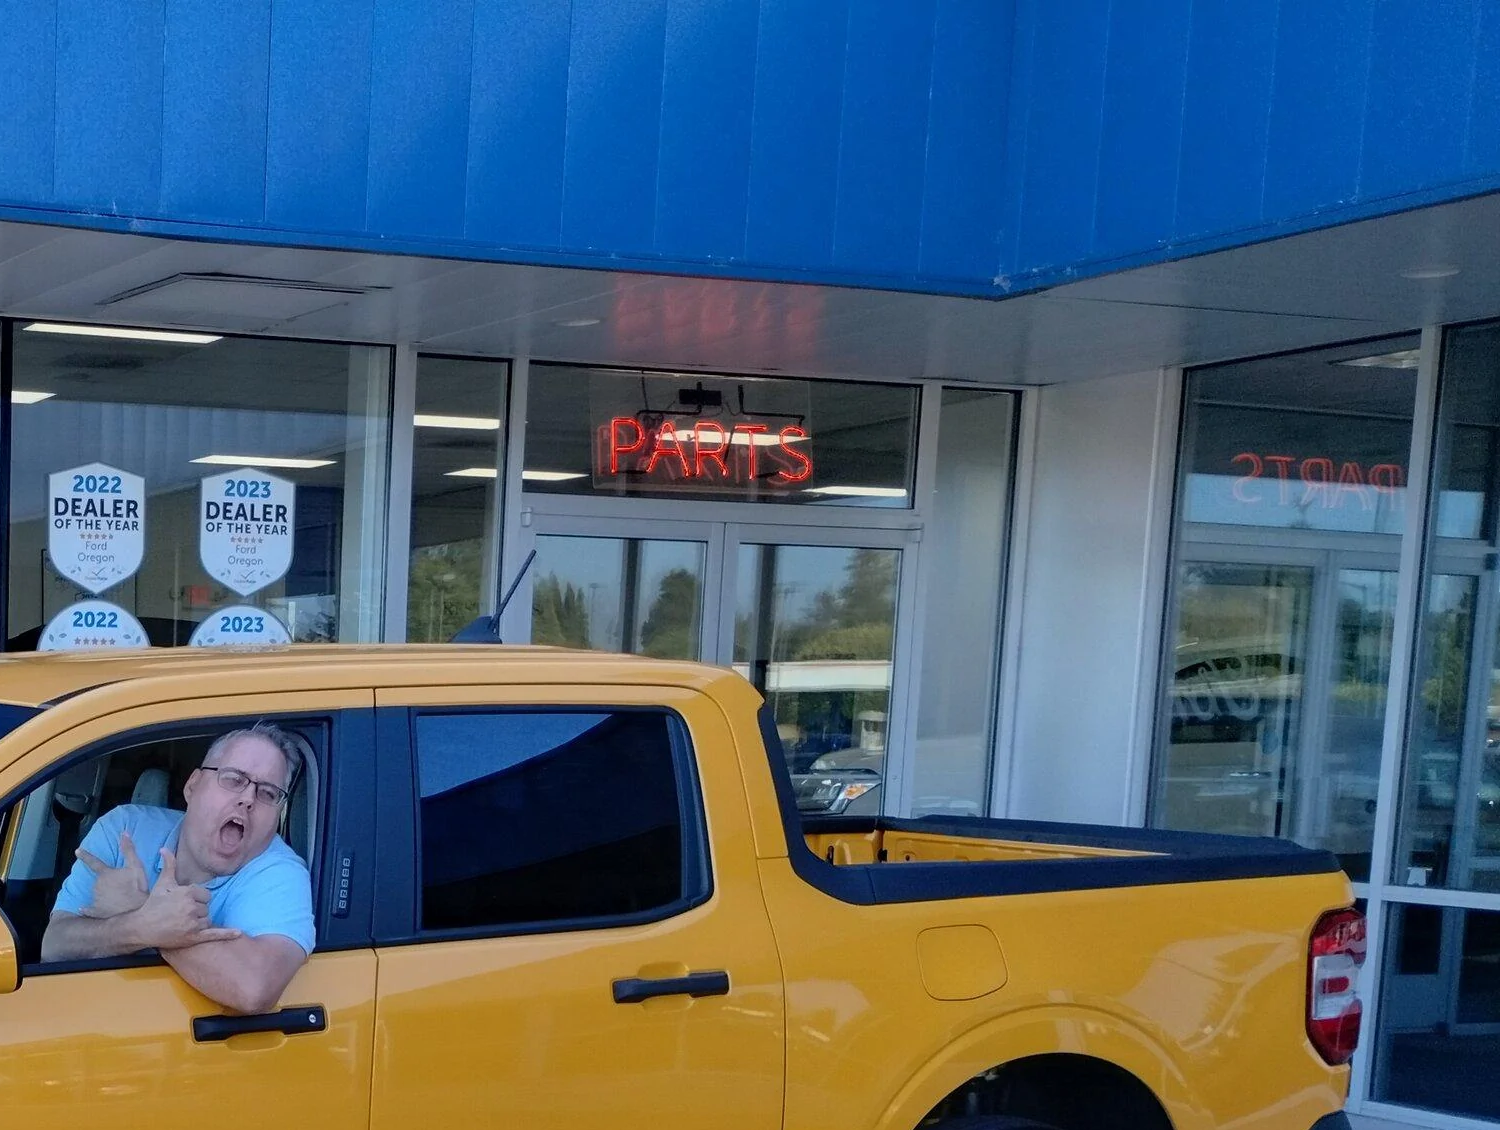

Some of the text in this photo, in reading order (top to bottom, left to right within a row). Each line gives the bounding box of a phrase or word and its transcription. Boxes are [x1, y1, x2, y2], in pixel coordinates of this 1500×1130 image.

[611, 416, 812, 480] PARTS
[72, 474, 122, 494] 2022
[224, 479, 271, 499] 2023
[54, 497, 139, 518] DEALER
[205, 501, 288, 523] DEALER
[54, 518, 139, 531] OF THE YEAR
[205, 522, 288, 536] OF THE YEAR
[85, 541, 107, 551] Ford
[235, 544, 257, 555] Ford
[77, 552, 115, 564] Oregon
[227, 555, 264, 567] Oregon
[72, 611, 118, 628] 2022
[220, 616, 264, 633] 2023
